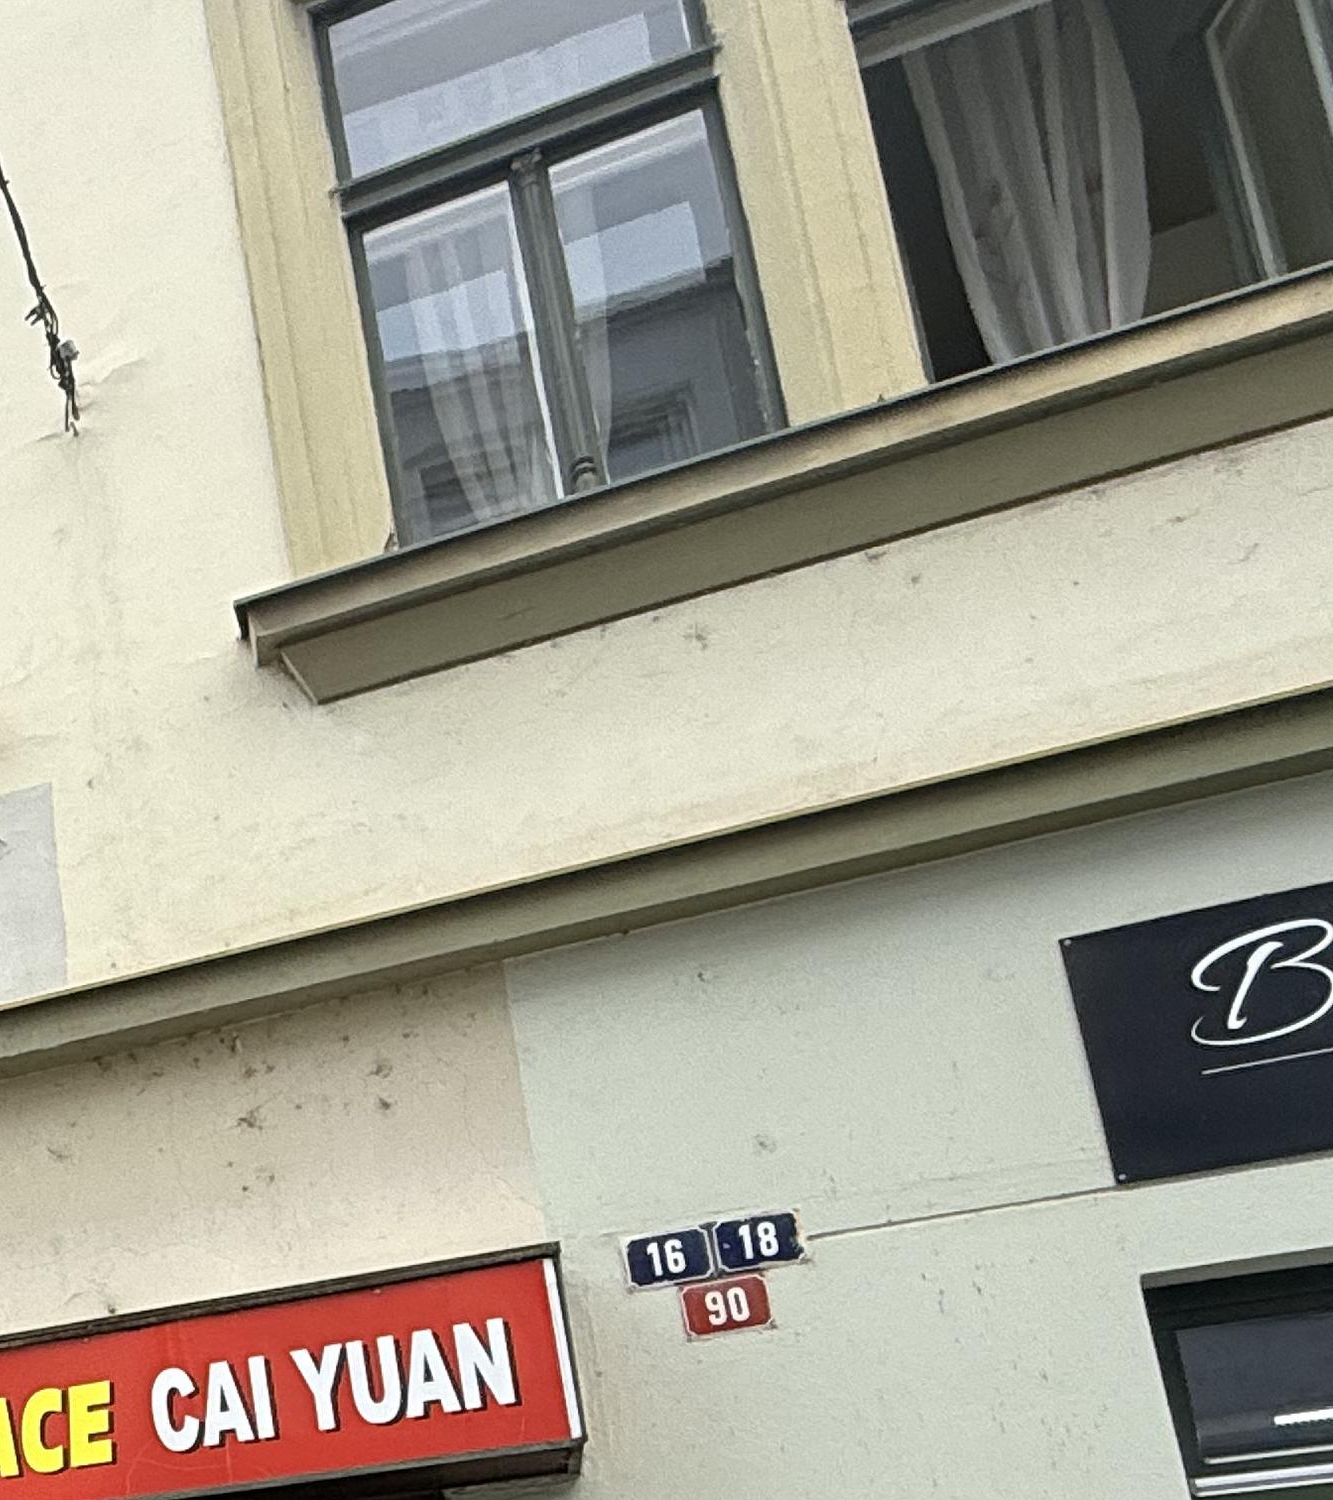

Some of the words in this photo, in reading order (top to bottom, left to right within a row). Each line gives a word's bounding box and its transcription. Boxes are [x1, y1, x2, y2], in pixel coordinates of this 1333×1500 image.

[646, 1239, 686, 1277] 16
[738, 1221, 779, 1260] 18
[704, 1287, 751, 1326] 90
[150, 1361, 277, 1454] CAI
[289, 1318, 517, 1432] YUAN
